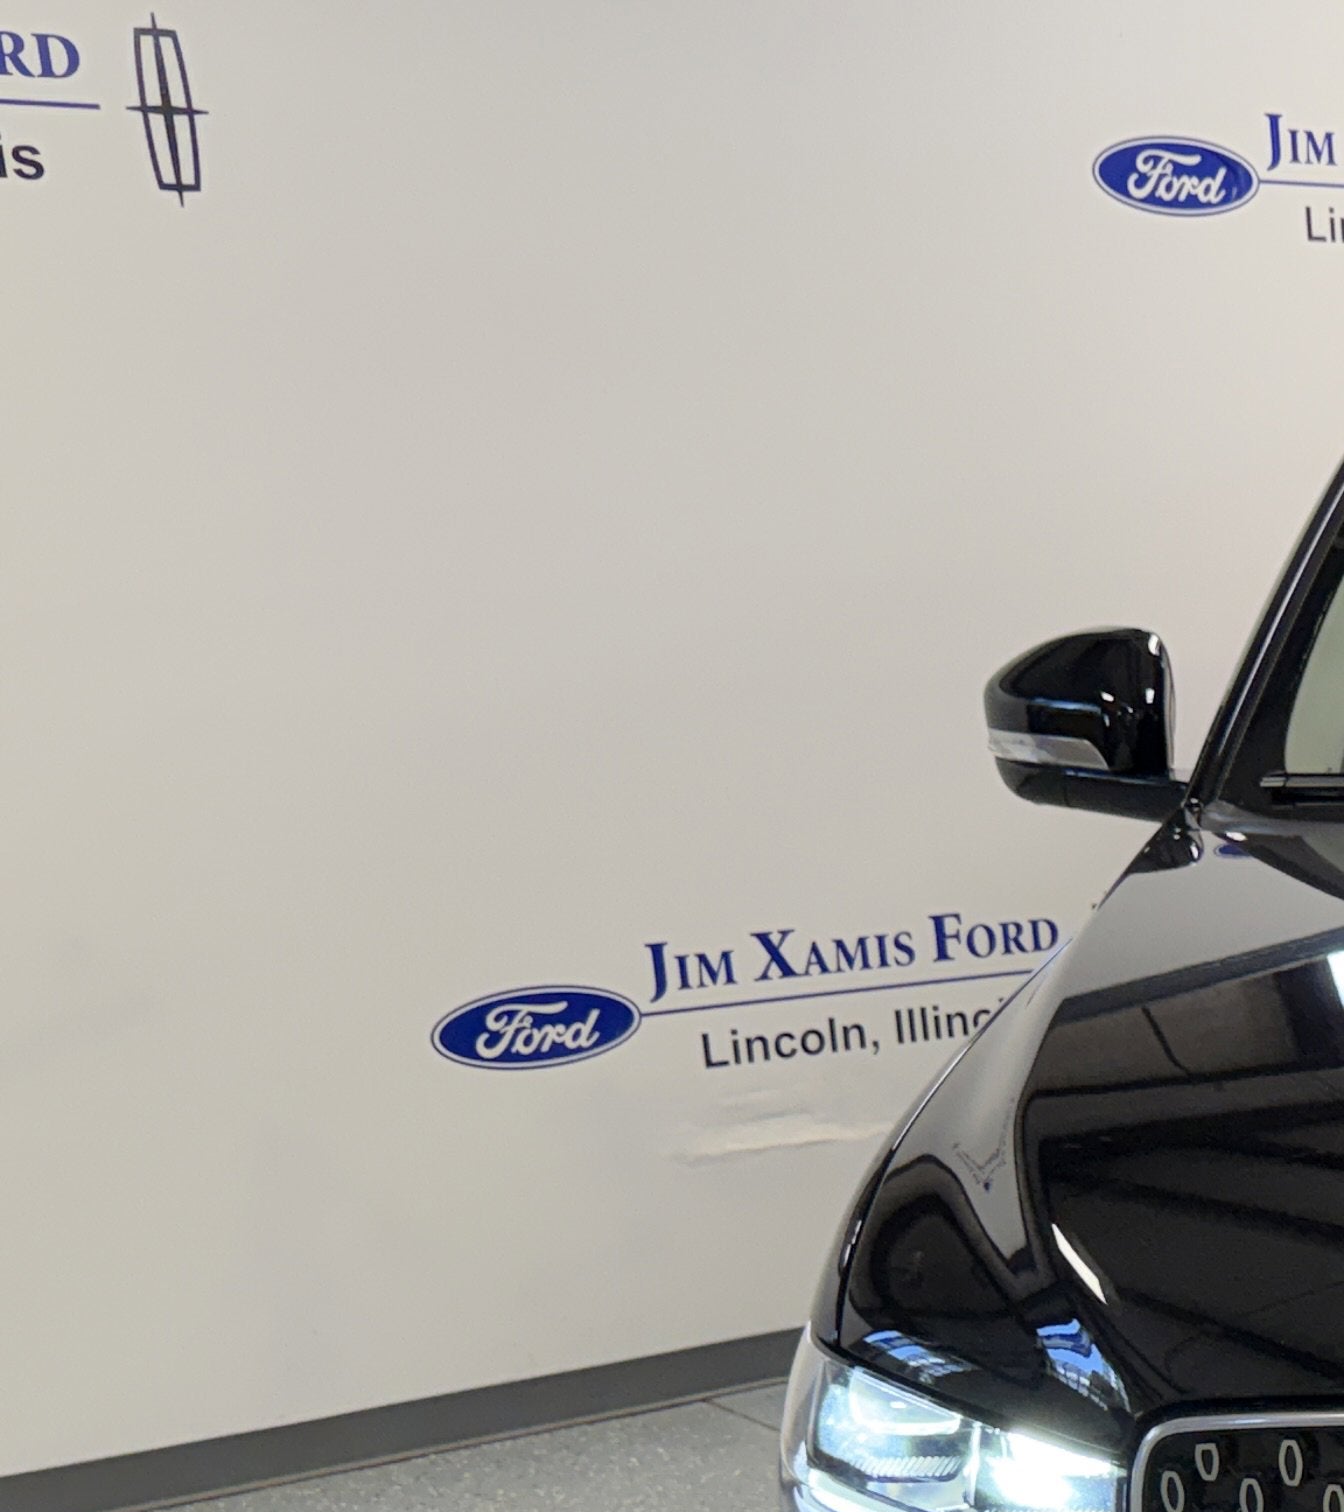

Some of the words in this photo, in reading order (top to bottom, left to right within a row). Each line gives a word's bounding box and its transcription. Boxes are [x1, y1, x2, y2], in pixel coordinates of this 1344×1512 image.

[1265, 112, 1336, 171] JIM
[1127, 148, 1227, 205] Ford
[644, 941, 737, 1003] JIM
[750, 928, 916, 982] XAMIS
[927, 912, 1060, 962] FORD
[475, 1001, 600, 1060] Ford
[700, 1017, 881, 1070] Lincoln,
[895, 997, 1004, 1043] Illin
